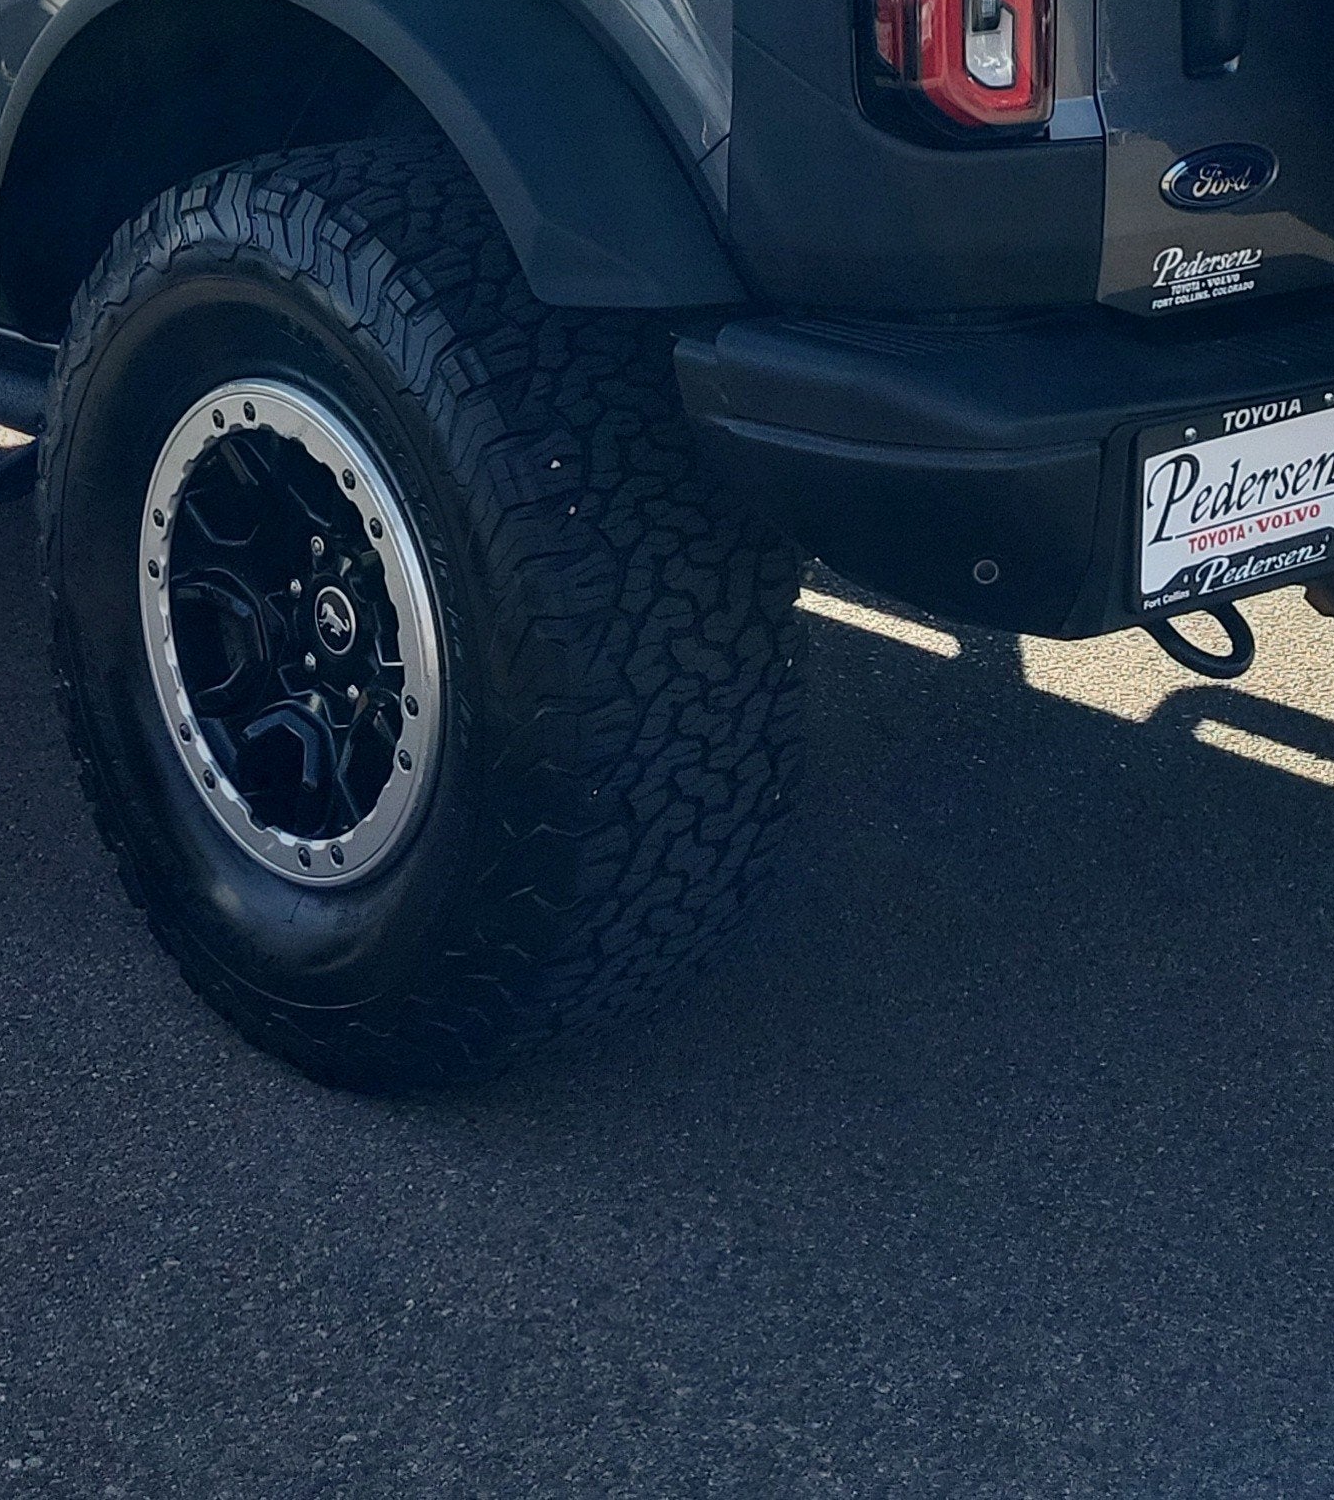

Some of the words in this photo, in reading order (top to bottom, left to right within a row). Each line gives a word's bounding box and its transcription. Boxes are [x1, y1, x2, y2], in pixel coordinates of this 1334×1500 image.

[1192, 163, 1252, 198] Ford
[1152, 247, 1262, 288] Pedersen
[1171, 281, 1200, 295] TOYOTA
[1207, 273, 1240, 288] VOLVO
[1152, 297, 1174, 309] FORT
[1212, 280, 1255, 297] COLORADO
[1222, 398, 1302, 432] TOYOTA
[1188, 524, 1246, 554] TOYOTA
[1256, 504, 1321, 533] VOLVO
[1195, 544, 1326, 595] Pedersen
[1143, 594, 1161, 610] Fort
[1162, 588, 1190, 605] Collins
